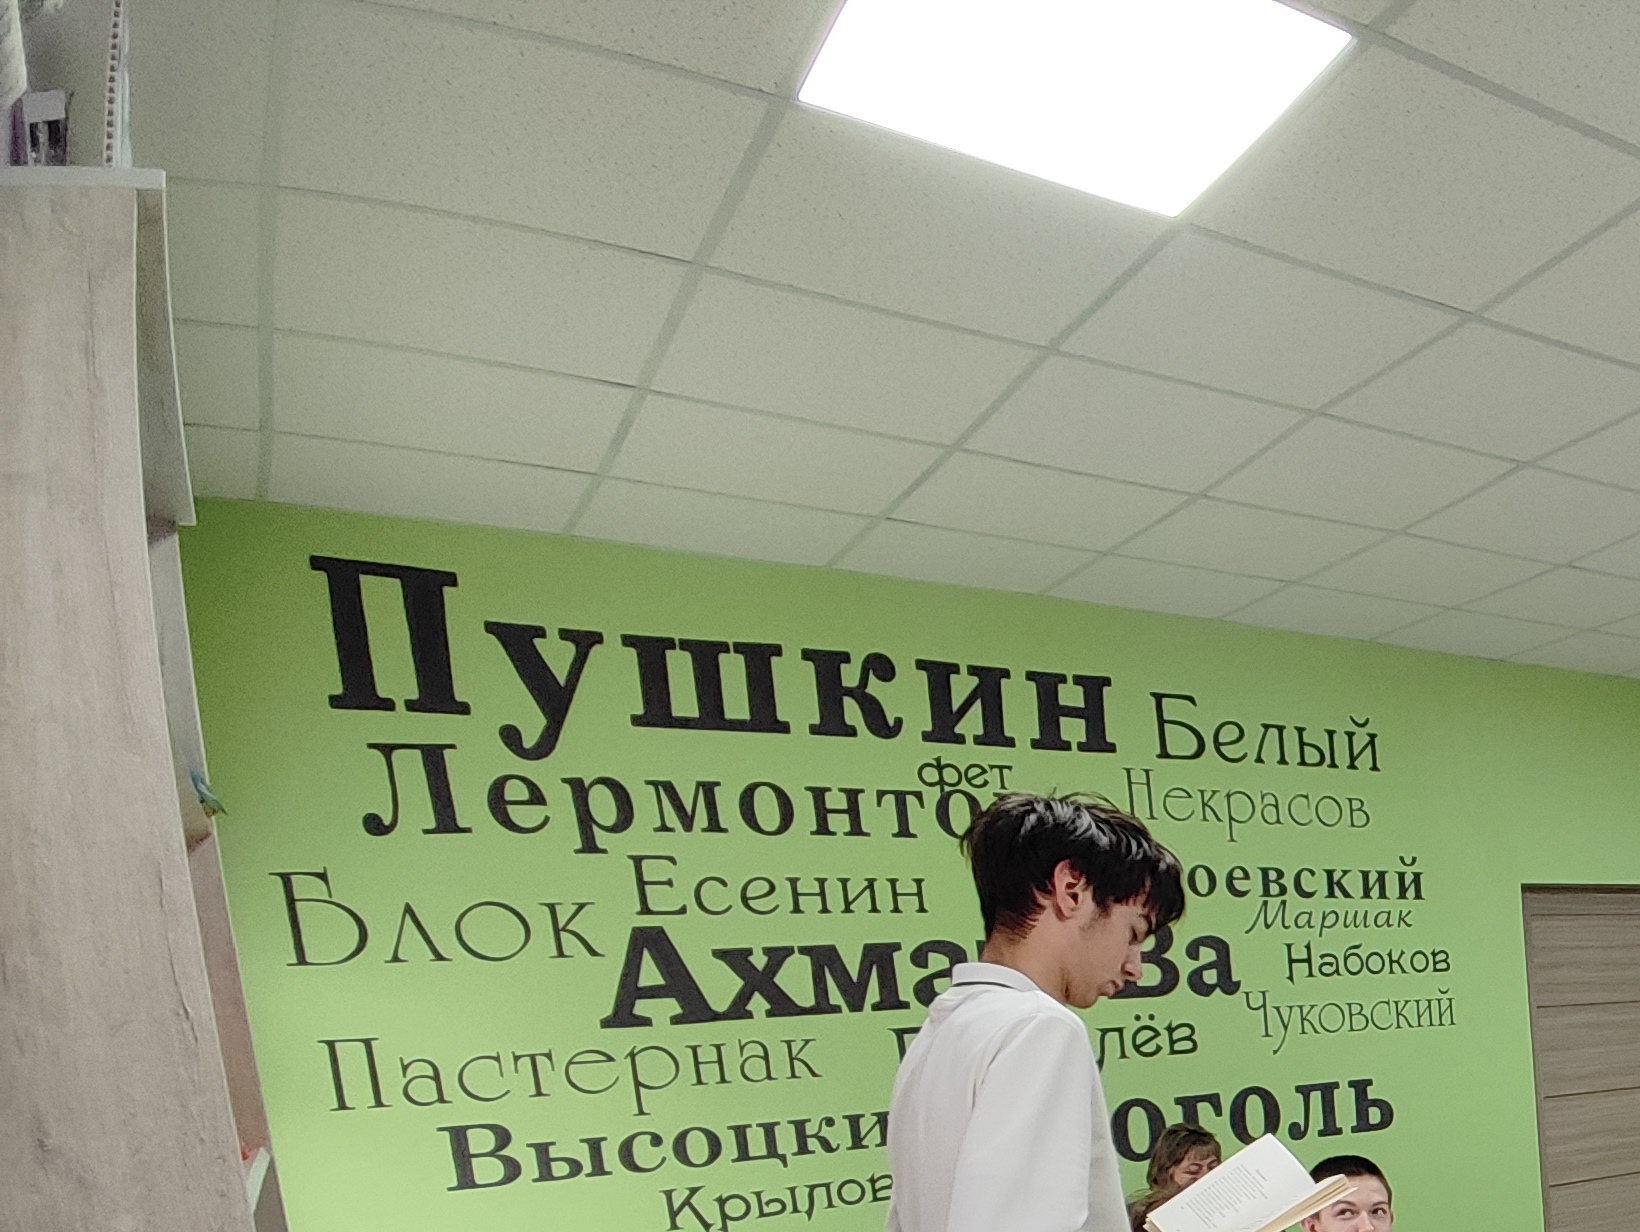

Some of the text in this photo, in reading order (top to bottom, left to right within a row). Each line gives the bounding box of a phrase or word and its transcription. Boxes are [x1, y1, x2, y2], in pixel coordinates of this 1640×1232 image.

[307, 552, 1117, 762] Пушкин
[1149, 691, 1382, 774] Белый
[361, 742, 1003, 855] Лермонто
[1122, 767, 1372, 843] Некрасов
[269, 866, 605, 967] Блок
[626, 854, 930, 916] Есенин
[1244, 899, 1414, 938] Маршак
[1284, 940, 1452, 984] Набоков
[1243, 988, 1457, 1056] Чуковский
[317, 1037, 823, 1118] Пастернак
[436, 1110, 890, 1192] Высоцки
[1110, 1078, 1395, 1165] оголь
